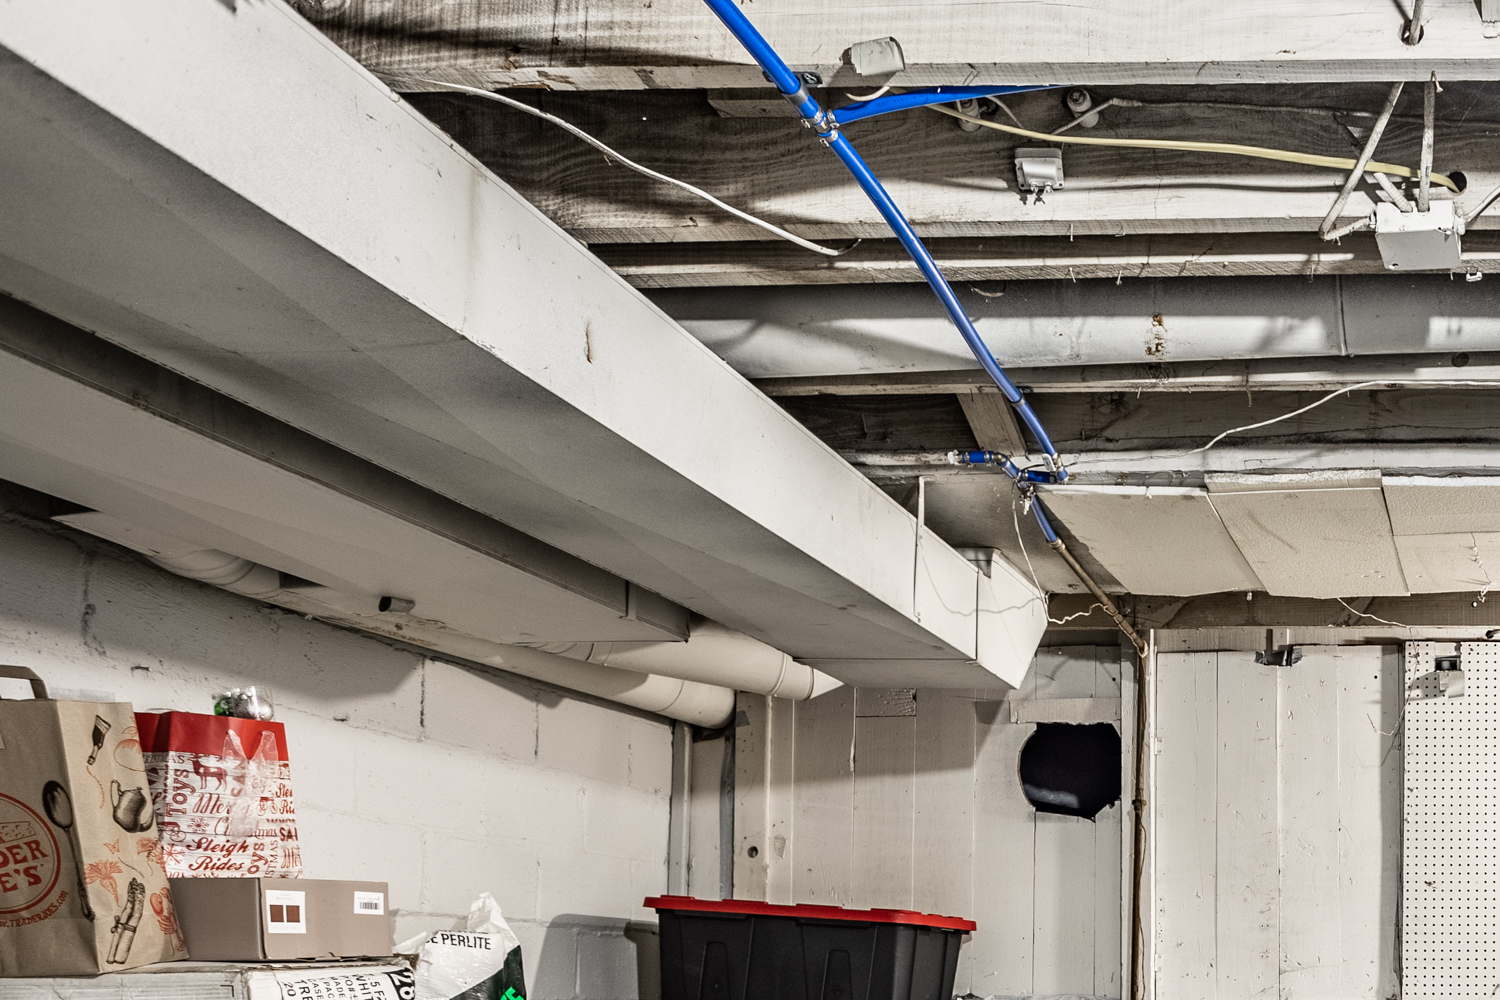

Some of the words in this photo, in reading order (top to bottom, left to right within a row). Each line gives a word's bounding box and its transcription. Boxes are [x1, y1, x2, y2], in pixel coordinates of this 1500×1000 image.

[165, 768, 197, 818] Toys
[186, 836, 250, 858] Sleigh
[188, 855, 245, 872] Rides
[440, 933, 492, 950] PERLITE
